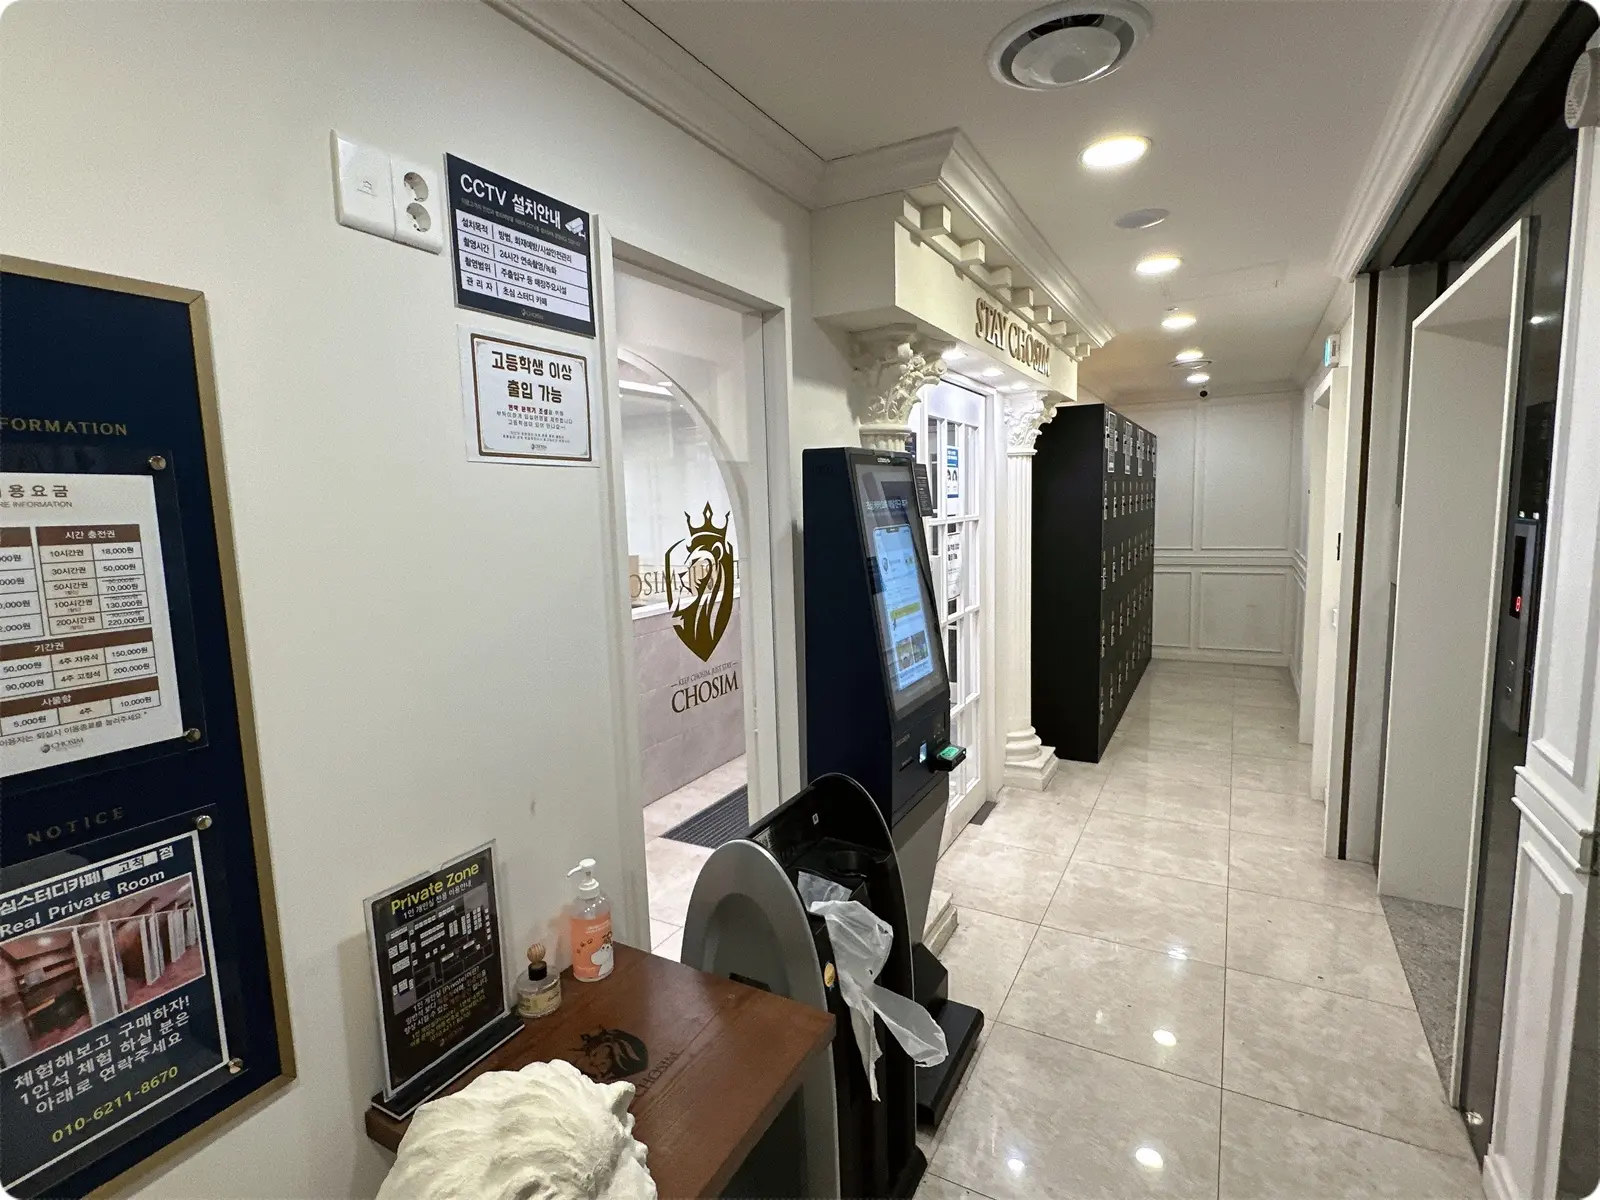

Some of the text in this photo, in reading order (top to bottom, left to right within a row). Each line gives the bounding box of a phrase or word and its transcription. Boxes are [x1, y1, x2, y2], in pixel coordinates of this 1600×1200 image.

[460, 173, 507, 206] CCTV
[512, 192, 561, 230] 설치안내
[461, 216, 489, 234] 설치목적
[463, 236, 490, 254] 촬영시간
[499, 249, 519, 264] 24시간
[465, 256, 491, 273] 촬영범위
[501, 267, 526, 282] 주출입구
[503, 286, 516, 298] 초심
[517, 290, 535, 303] 스터디
[536, 294, 548, 306] 카페
[975, 297, 1050, 377] STAY CHOSIM
[491, 350, 573, 381] 고등학생 이상
[507, 379, 562, 404] 출입 가능
[12, 500, 73, 508] INFORMATION
[65, 530, 84, 540] 시간
[50, 549, 84, 558] 10시간권
[101, 547, 134, 555] 18,000원
[52, 566, 86, 575] 30시간권
[103, 563, 136, 572] 50,000원
[53, 582, 89, 591] 50시간권
[106, 583, 138, 592] 70,000원
[54, 600, 93, 609] 100시간권
[106, 600, 143, 609] 130,000원
[56, 616, 96, 626] 200시간권
[108, 616, 145, 626] 220,000원
[34, 642, 65, 653] 기간권
[3, 647, 148, 673] 50,000원 4주 자유석 150,000원
[5, 679, 45, 691] 90,000원
[77, 670, 101, 680] 고정석
[113, 663, 150, 674] 200,000원
[678, 675, 689, 686] KEEP
[41, 694, 72, 706] 사물함
[671, 670, 739, 713] CHOSIM
[13, 696, 152, 728] 5,000원 4주 10,000원
[27, 806, 123, 846] NOTICE
[118, 855, 145, 874] 고척
[159, 845, 174, 860] 점
[391, 863, 479, 915] Private Zone
[0, 870, 165, 938] Real Private Room
[403, 909, 415, 920] 1인
[416, 899, 435, 913] 개인실
[14, 995, 190, 1090] 체험해보고 구매하자!
[20, 1011, 190, 1105] 1인석 체험 하실 분은
[35, 1032, 183, 1114] 아래로 연락주세요
[51, 1066, 179, 1143] 010-6211-8670
